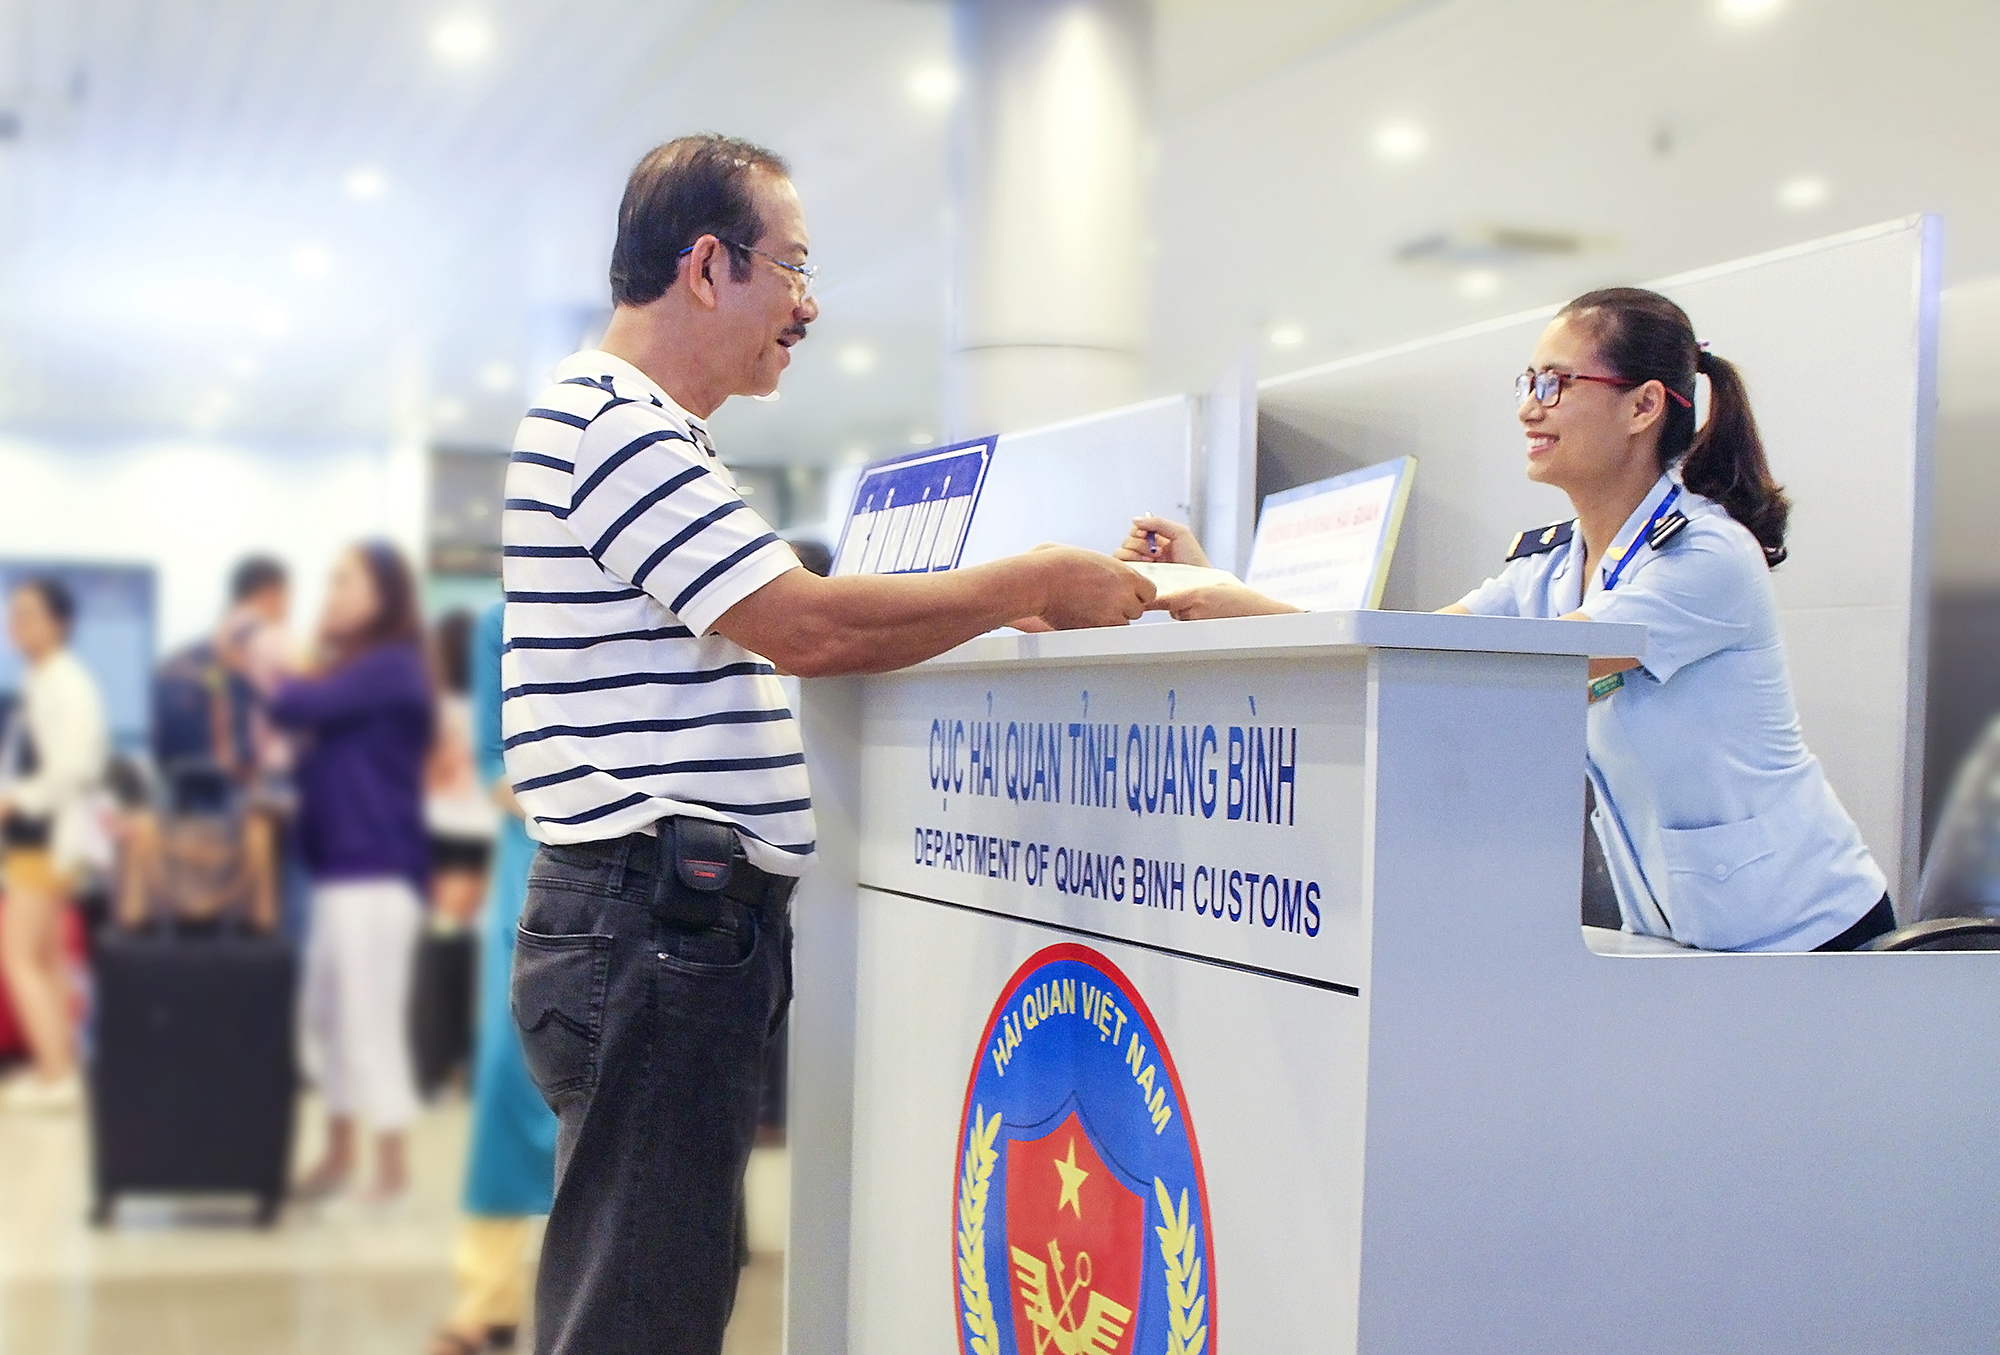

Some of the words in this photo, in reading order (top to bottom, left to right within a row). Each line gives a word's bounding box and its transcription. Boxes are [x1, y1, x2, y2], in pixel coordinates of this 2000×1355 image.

[1005, 720, 1062, 806] QUAN
[1125, 689, 1218, 819] QUẢNG
[1227, 695, 1297, 827] BÌNH
[914, 827, 1020, 882] DEPARTMENT
[1025, 842, 1050, 886] OF
[1055, 846, 1126, 902] QUANG
[1133, 857, 1185, 912] BINH
[1194, 865, 1321, 938] CUSTOMS
[1022, 978, 1076, 1030] QUAN
[1081, 981, 1128, 1046] VIỆT
[1125, 1032, 1172, 1135] NAM
